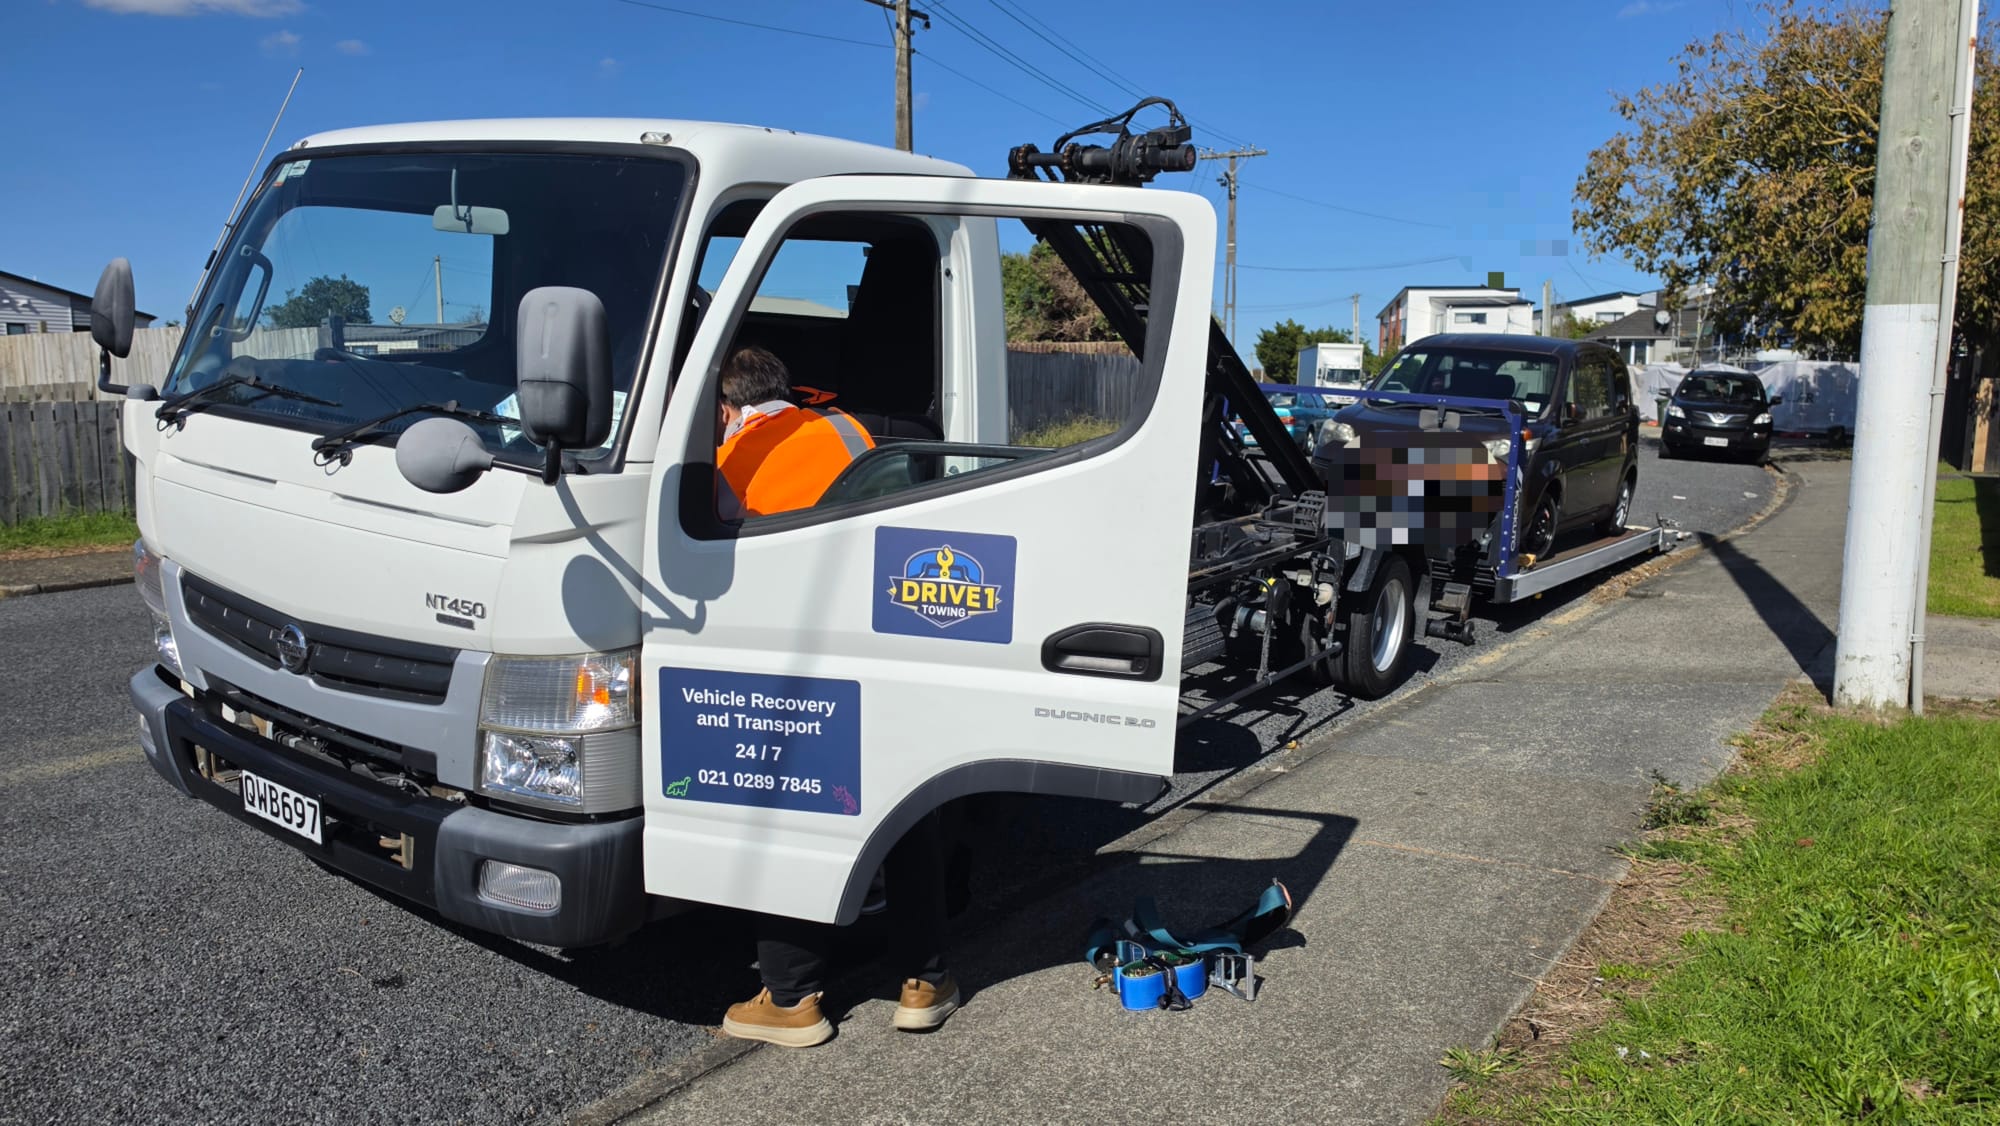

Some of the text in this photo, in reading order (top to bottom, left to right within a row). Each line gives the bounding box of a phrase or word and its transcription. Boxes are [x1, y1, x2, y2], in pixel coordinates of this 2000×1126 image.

[425, 592, 487, 619] NT450
[921, 604, 966, 618] TOWING
[682, 687, 836, 717] Vehicle Recovery
[696, 712, 822, 736] and Transport
[1034, 707, 1156, 729] DUONIC 2.0
[698, 769, 822, 794] 021 0289 7845
[244, 774, 318, 835] QWB697
